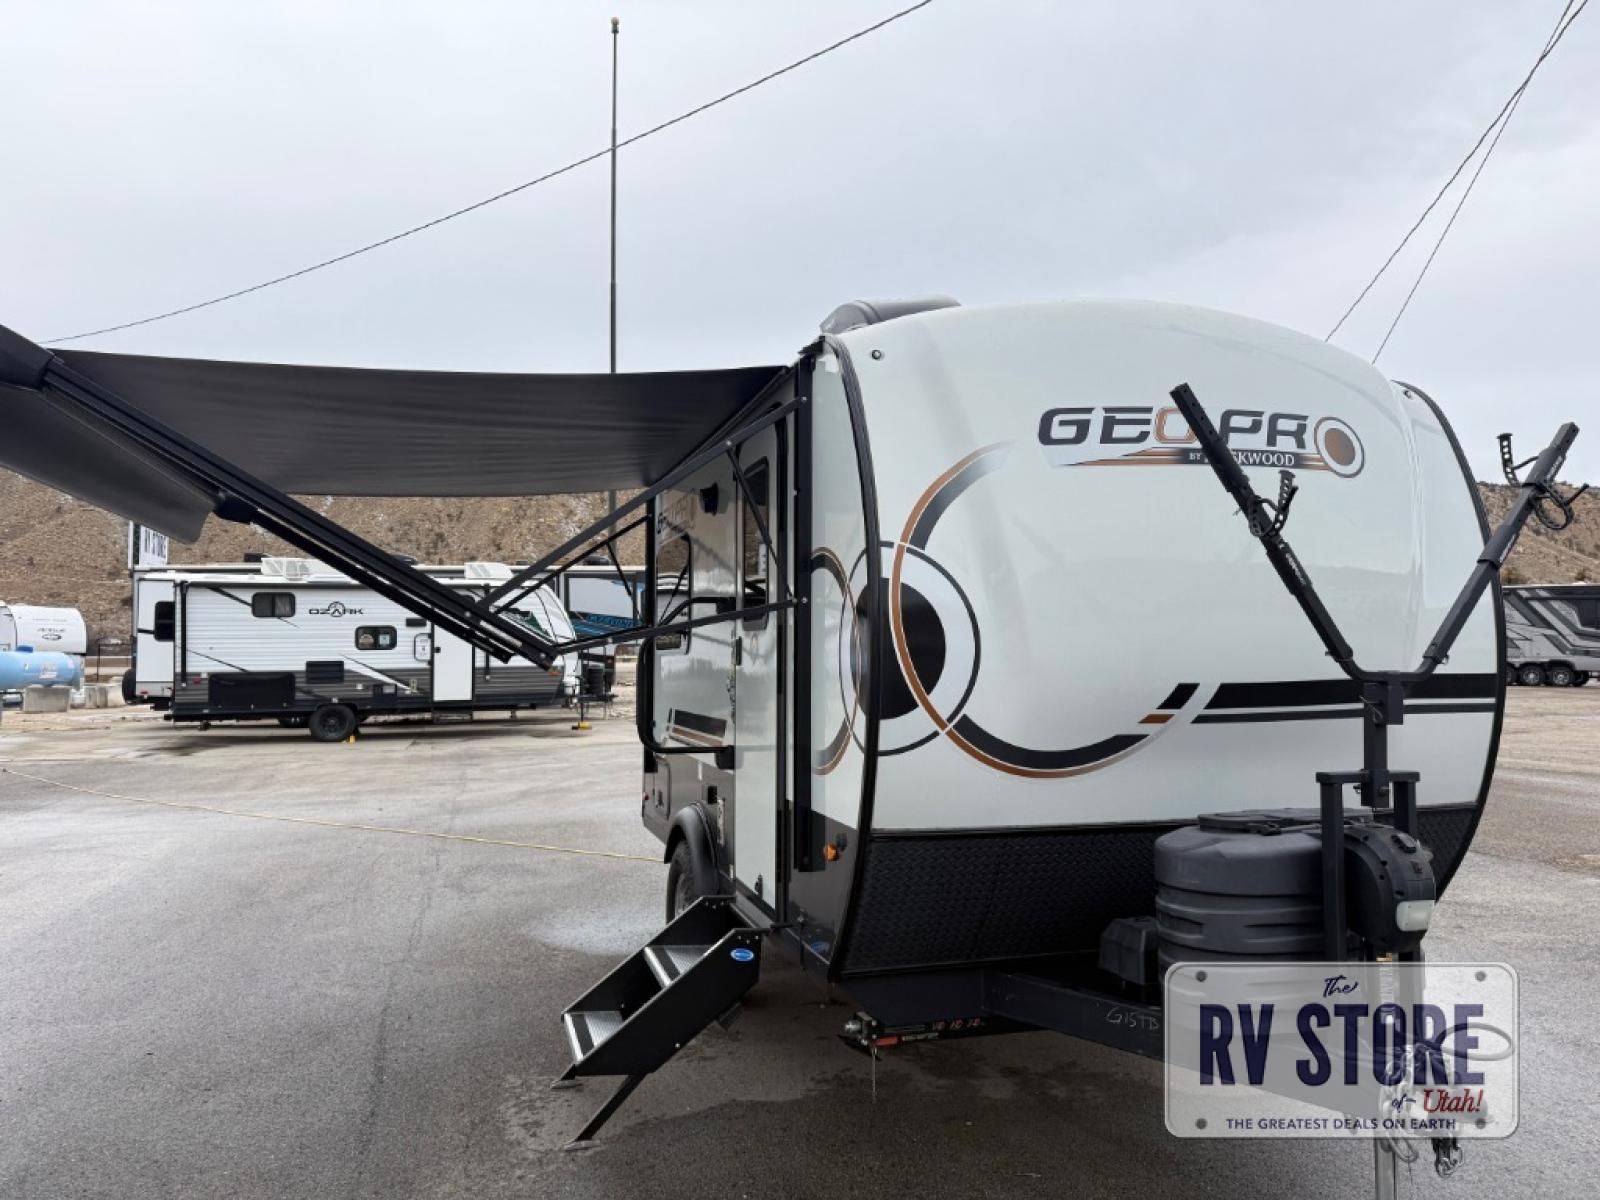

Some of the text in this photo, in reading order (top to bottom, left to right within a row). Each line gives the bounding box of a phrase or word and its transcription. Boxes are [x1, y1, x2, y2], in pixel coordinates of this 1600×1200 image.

[1038, 406, 1202, 446] GEO
[1189, 452, 1203, 461] BY
[308, 600, 365, 617] OZARK
